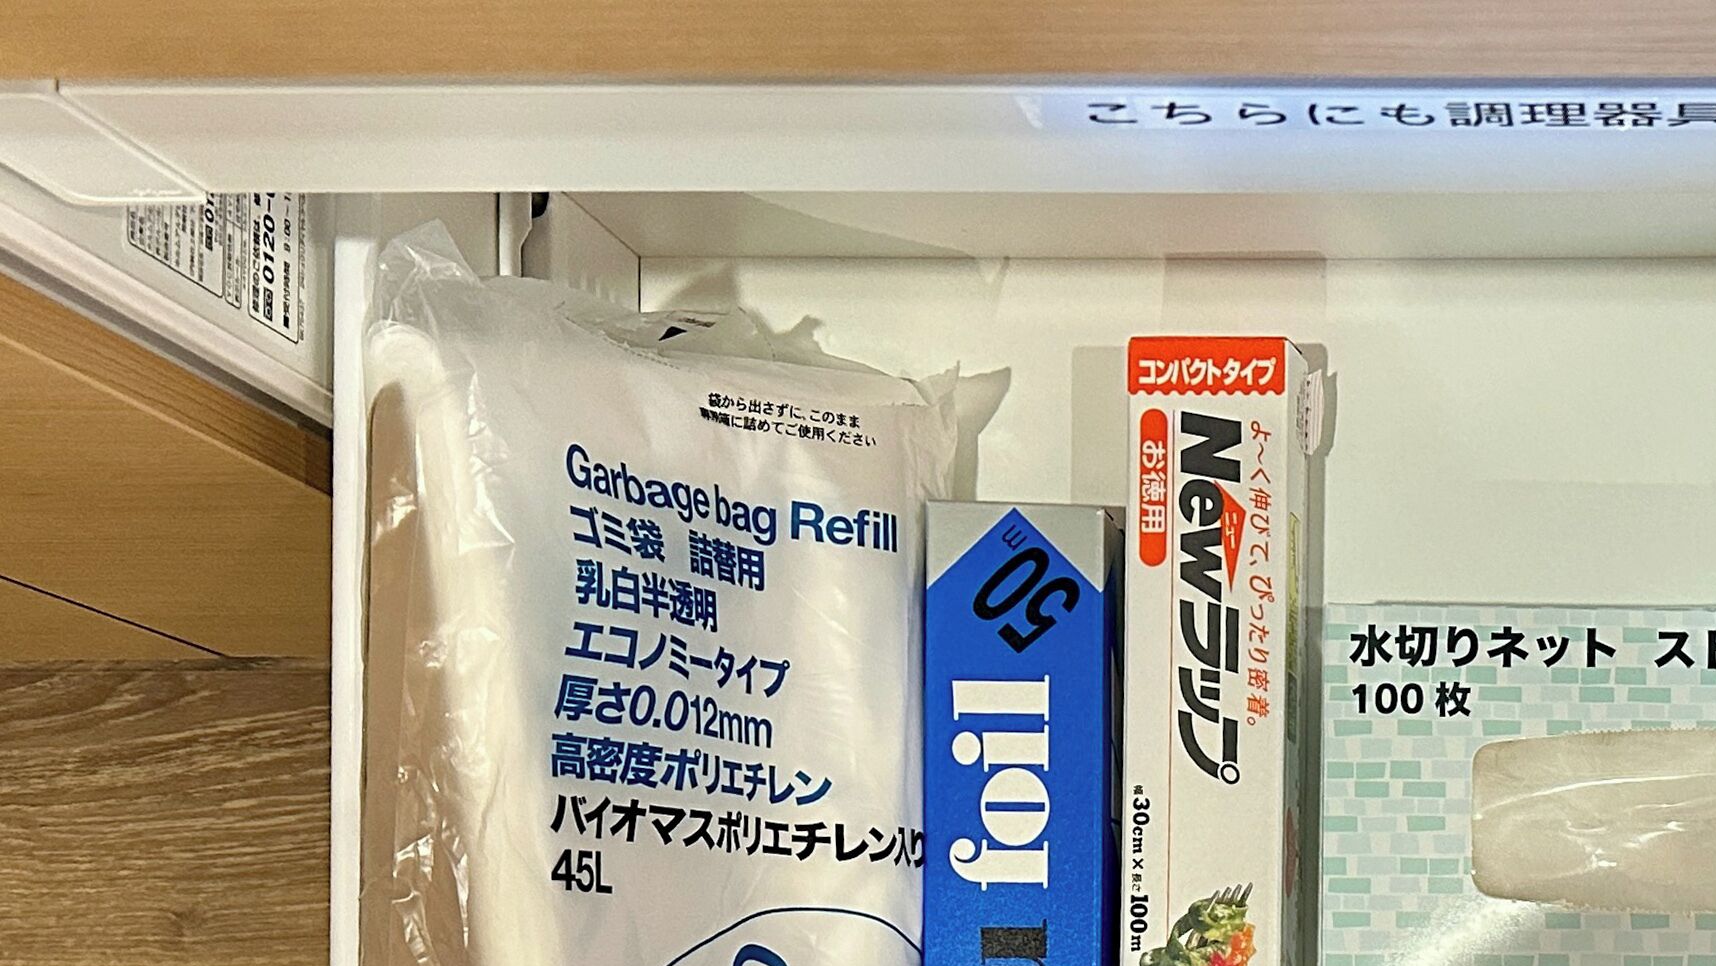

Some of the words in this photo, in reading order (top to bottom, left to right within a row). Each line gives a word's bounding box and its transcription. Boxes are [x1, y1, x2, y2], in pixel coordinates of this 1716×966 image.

[1137, 356, 1277, 387] コンパクトタイプ
[565, 443, 710, 522] Garbage
[714, 483, 778, 546] bag
[789, 500, 899, 553] Refill
[1141, 441, 1166, 534] お徳用
[569, 504, 667, 564] ゴミ袋
[688, 530, 767, 593] 詰替用
[575, 558, 719, 633] 乳白半透明
[564, 621, 791, 698] エコノミータイプ
[1348, 624, 1618, 670] 水切りネット
[554, 674, 773, 749] 厚さ0.012mm
[550, 732, 833, 806] 高密度ポリエチレン
[948, 674, 1050, 891] foil
[550, 794, 925, 869] バイオマスポリエチレン入り
[550, 848, 614, 896] 45L
